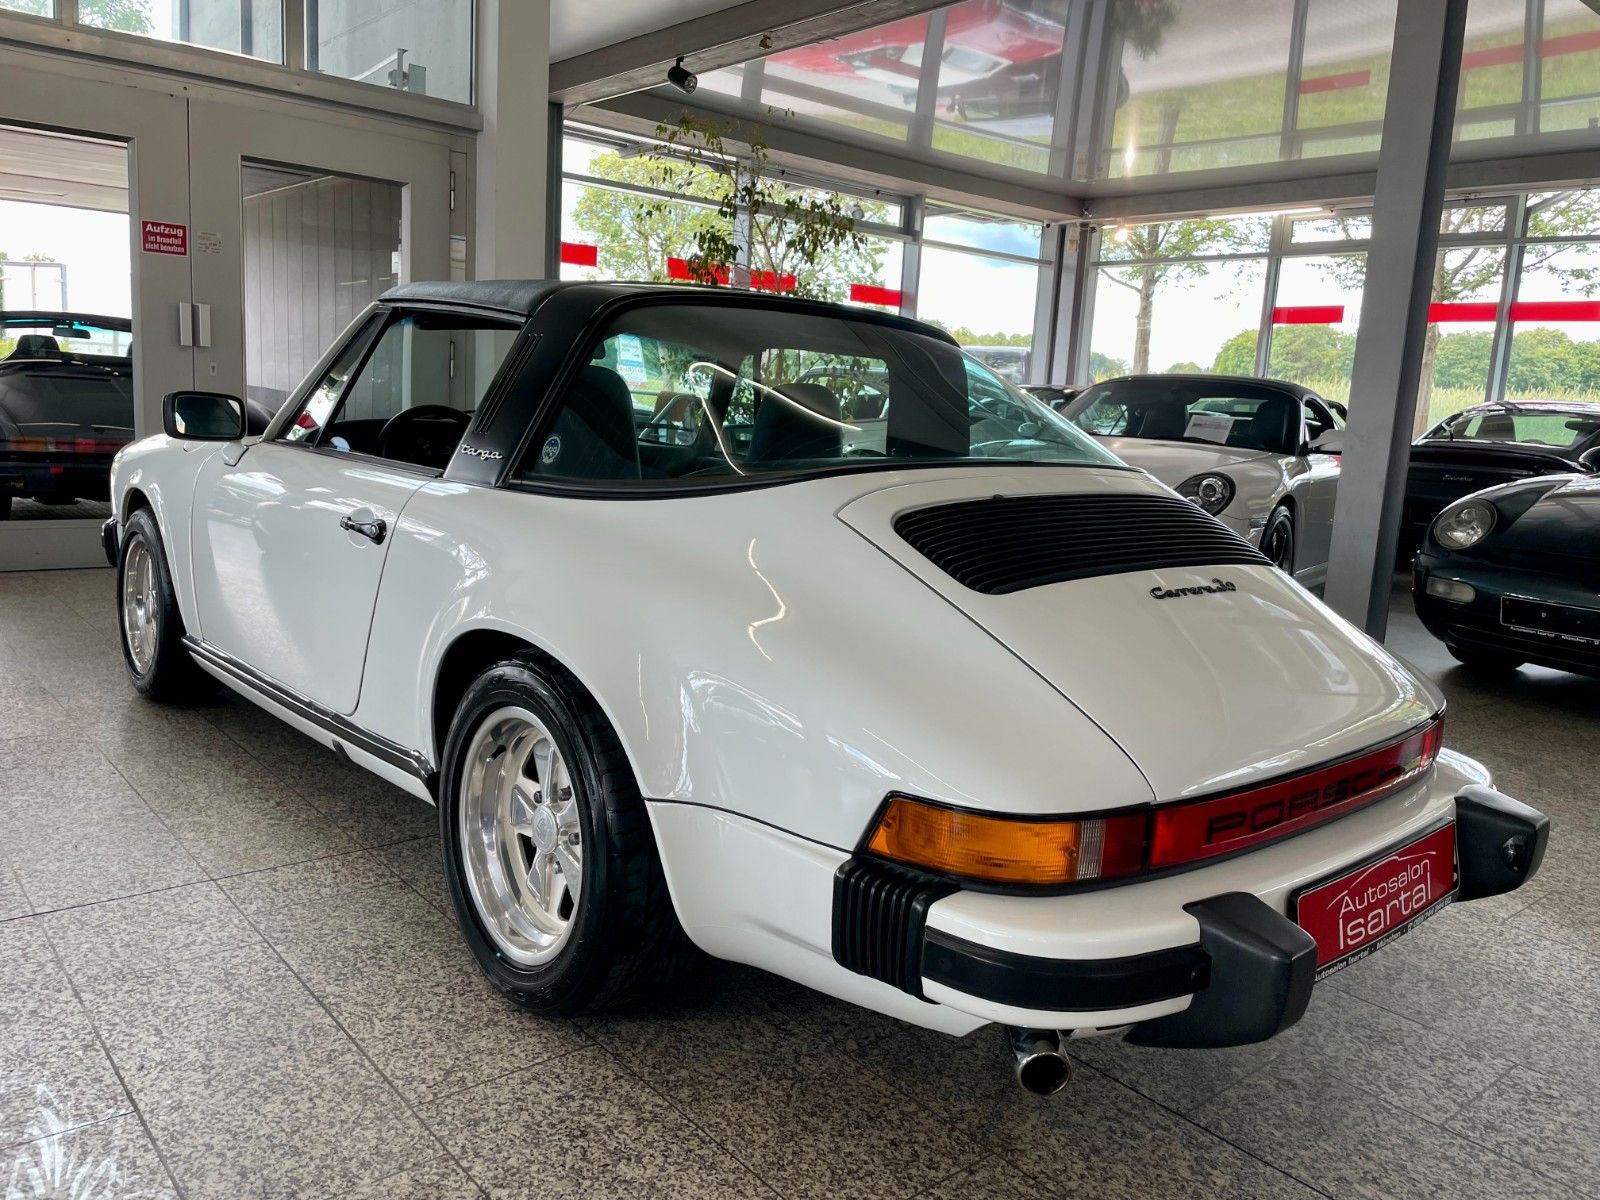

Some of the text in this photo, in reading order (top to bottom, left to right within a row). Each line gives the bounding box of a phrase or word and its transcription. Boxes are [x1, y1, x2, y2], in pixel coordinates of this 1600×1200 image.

[145, 223, 183, 237] Aufzug
[157, 236, 182, 245] Brandfall
[160, 244, 185, 253] benutzen
[461, 444, 502, 460] targa
[1150, 586, 1217, 599] Carrera
[1340, 859, 1430, 918] Autosalon
[1339, 872, 1431, 949] Isartal
